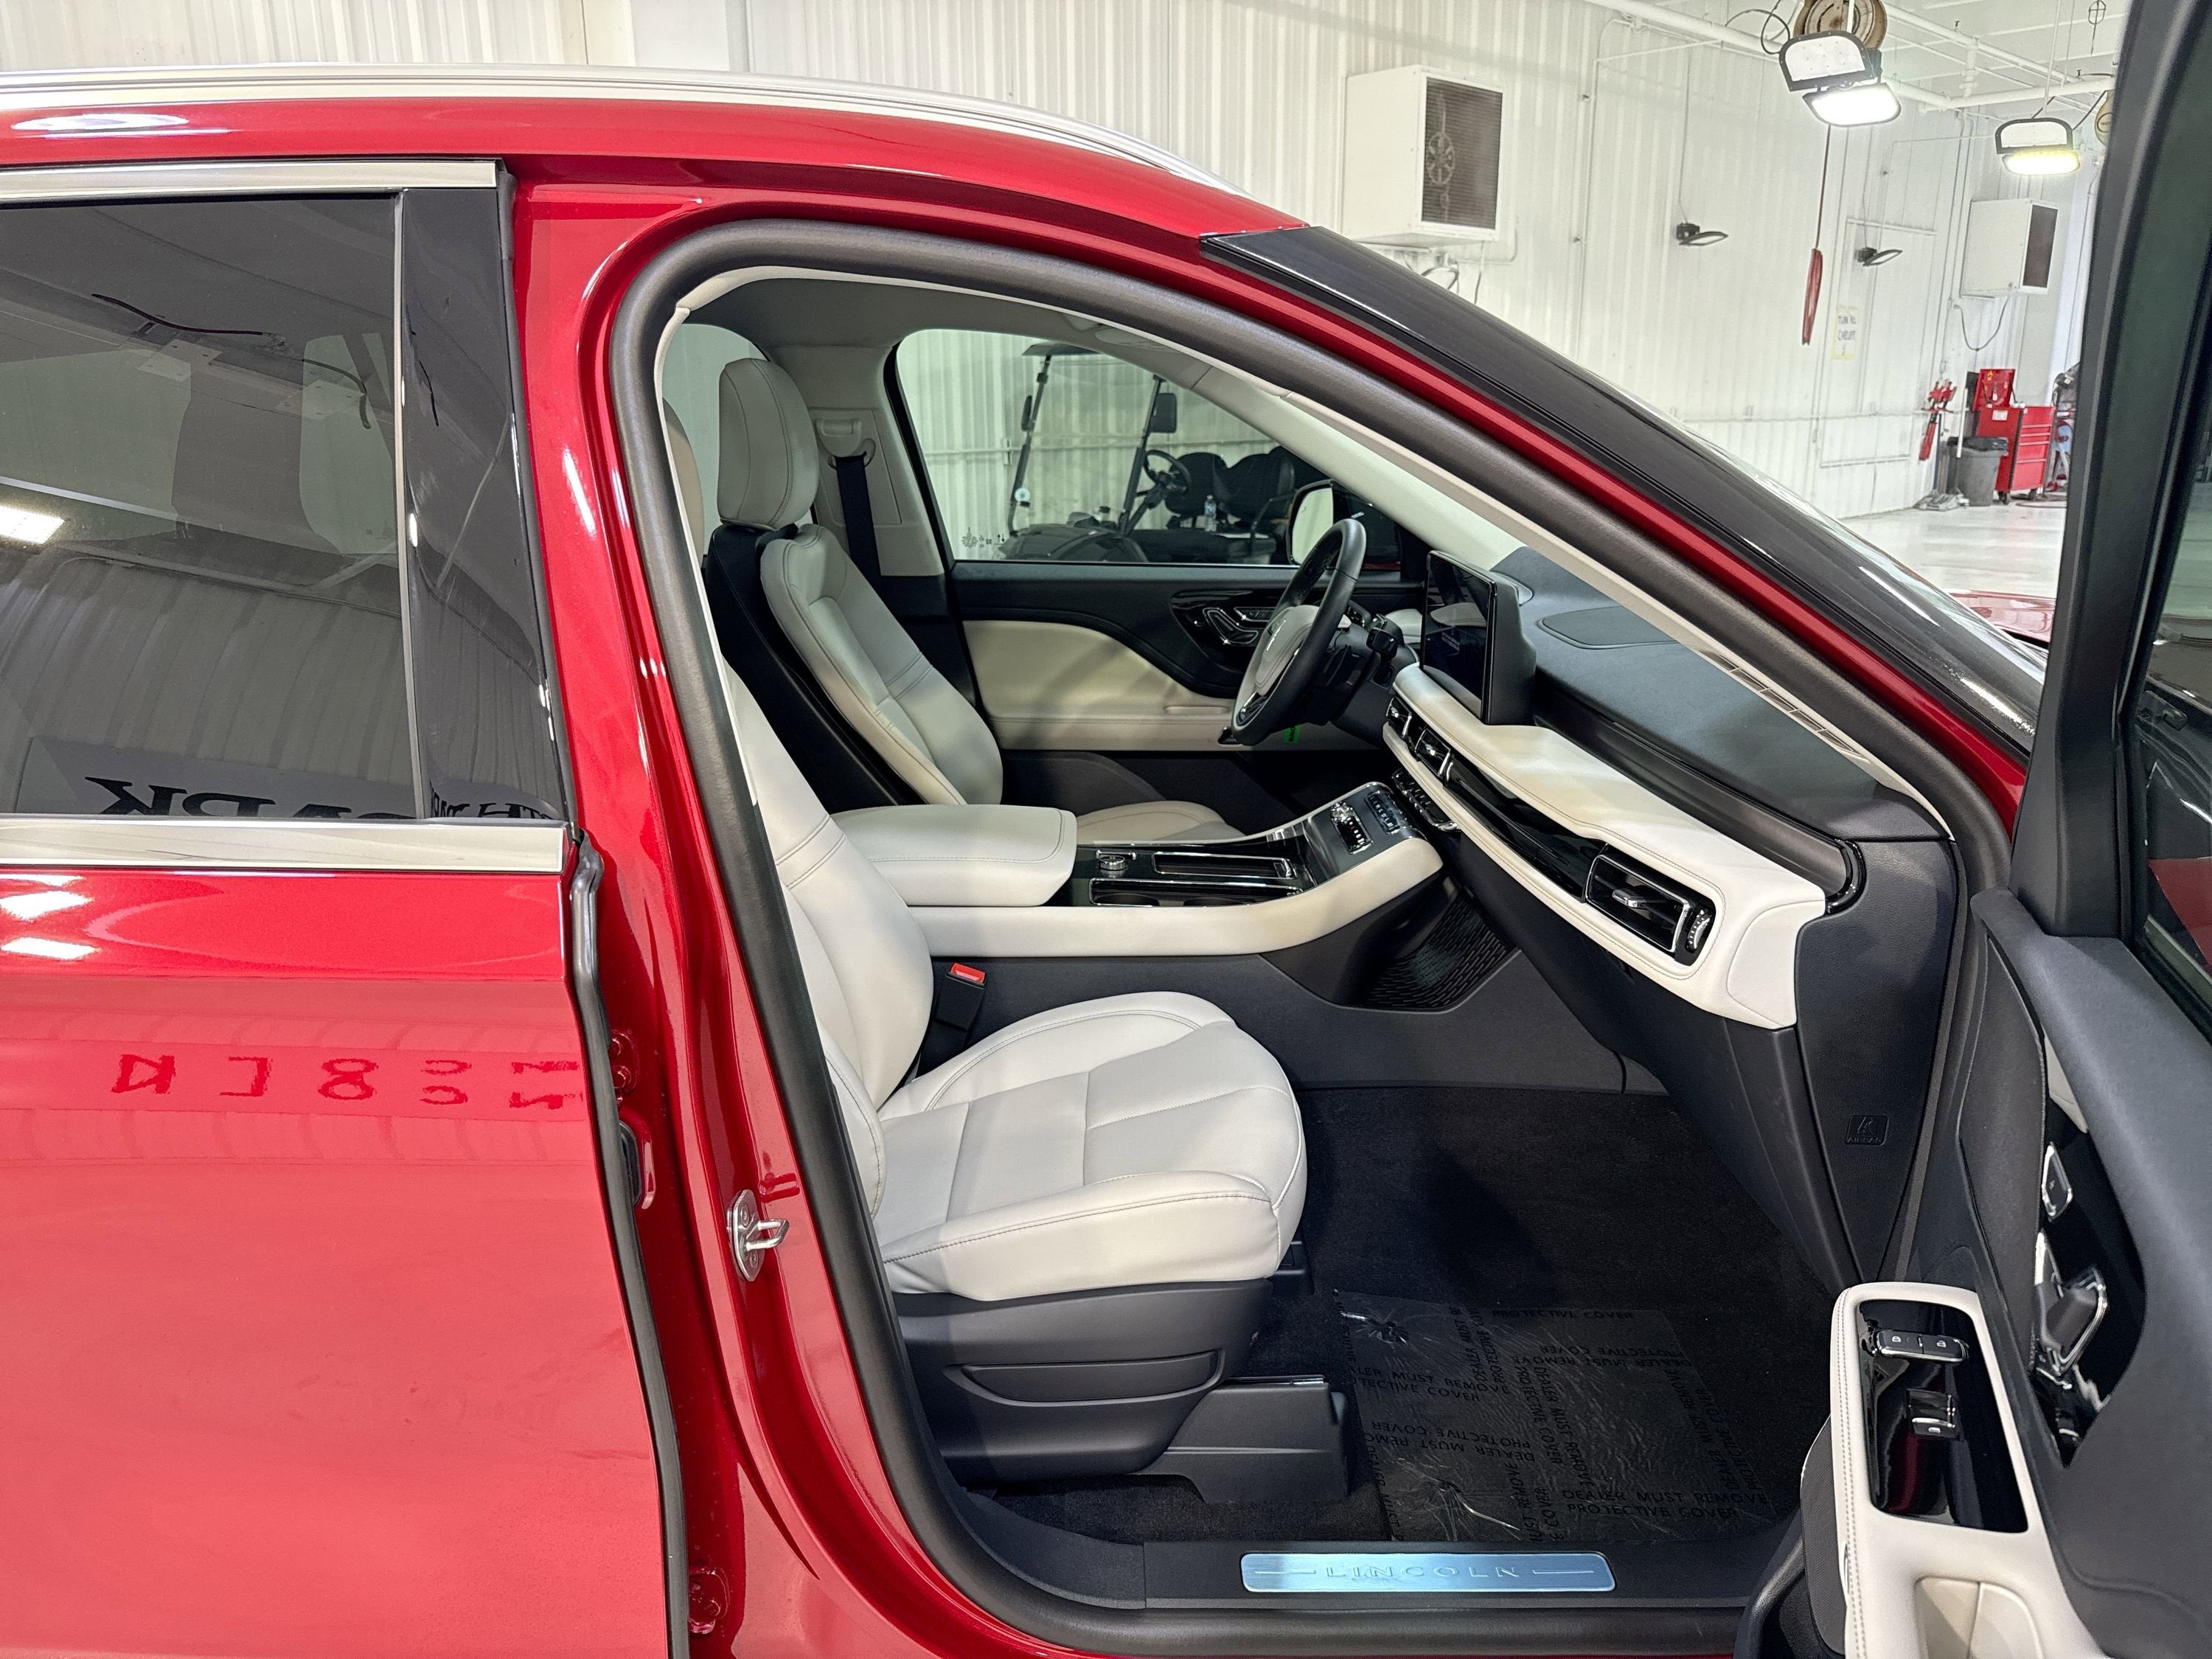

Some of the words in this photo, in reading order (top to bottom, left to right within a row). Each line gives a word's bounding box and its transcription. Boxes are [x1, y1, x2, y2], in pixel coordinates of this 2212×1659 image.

[1392, 1369, 1435, 1383] MUST
[1444, 1377, 1512, 1394] REMOVE
[1427, 1385, 1481, 1402] COVER
[1371, 1420, 1427, 1436] COVER
[1419, 1439, 1465, 1453] MUST
[1437, 1427, 1531, 1449] PROTECTIVE
[1539, 1427, 1562, 1464] COVER
[1475, 1445, 1536, 1463] DEALER
[1550, 1407, 1573, 1436] MUST
[1564, 1441, 1594, 1488] REMOVE
[1562, 1489, 1627, 1501] DEALER
[1636, 1491, 1684, 1503] MUST
[1694, 1492, 1770, 1505] REMOVE
[1566, 1503, 1671, 1517] PROTECTIVE
[1678, 1506, 1739, 1519] COVER
[1325, 1565, 1520, 1579] LINCOLN
